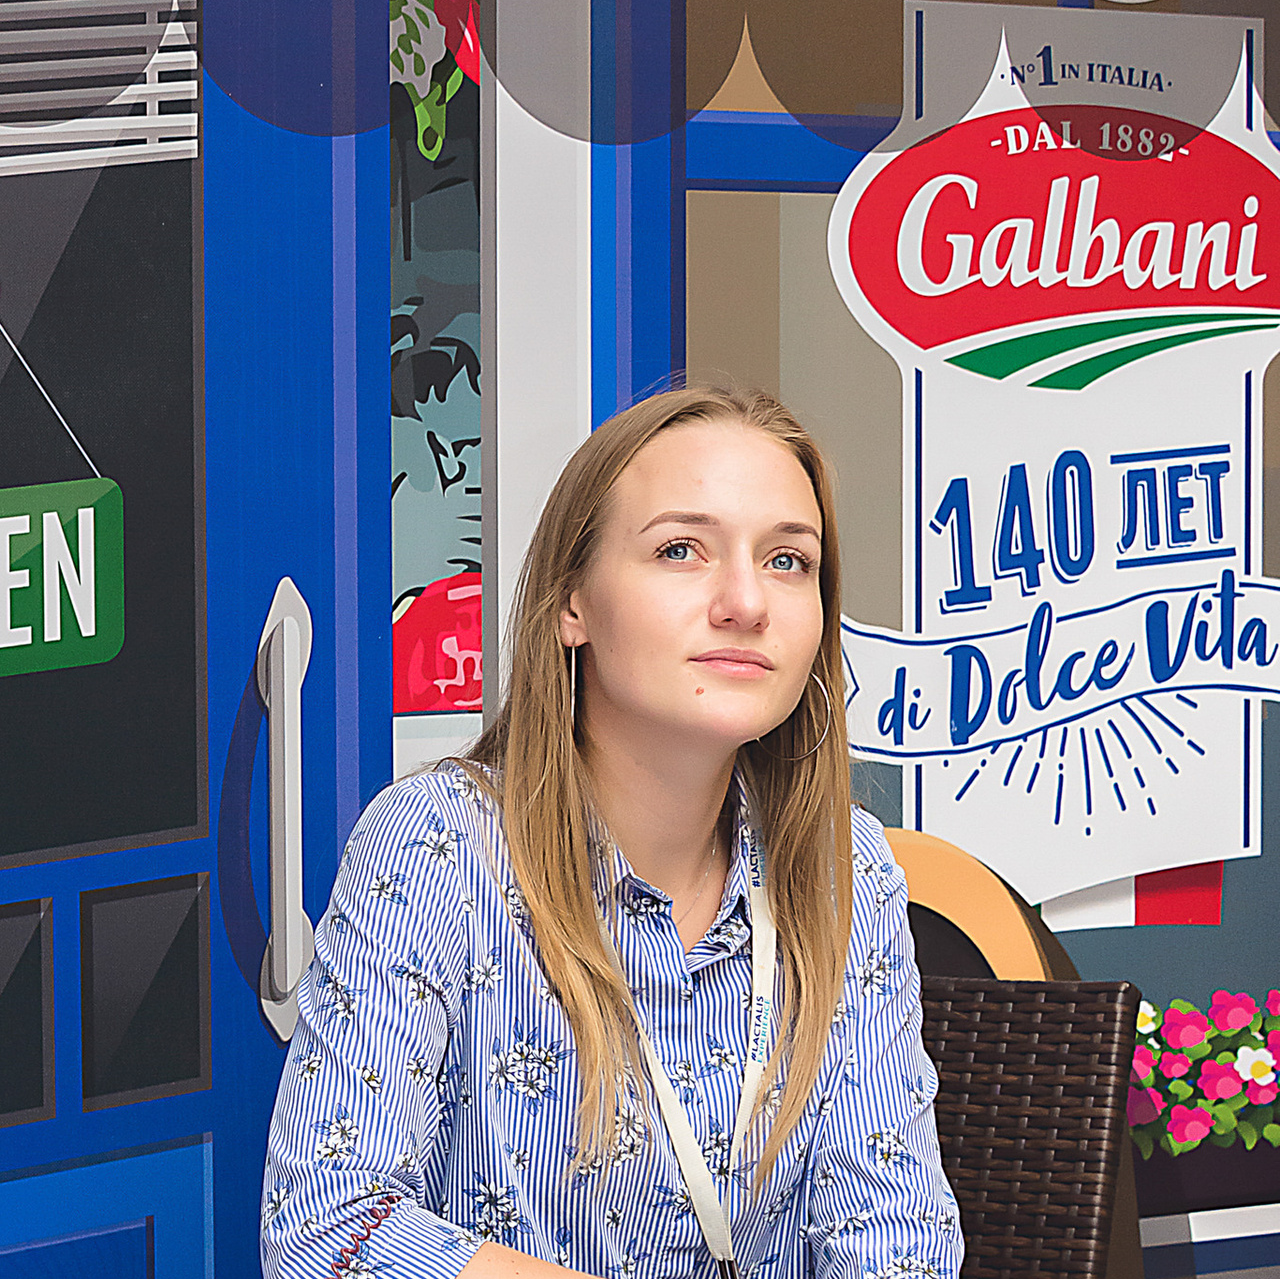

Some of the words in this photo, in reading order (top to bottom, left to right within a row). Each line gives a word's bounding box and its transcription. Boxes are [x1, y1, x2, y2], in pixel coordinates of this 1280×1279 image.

[1060, 63, 1080, 79] IN
[896, 173, 1268, 297] Galbani
[929, 449, 1096, 615] 140
[1116, 460, 1231, 555] ЛЕТ
[877, 667, 932, 747] di
[942, 601, 1136, 746] Dolce
[1145, 568, 1278, 684] Vita
